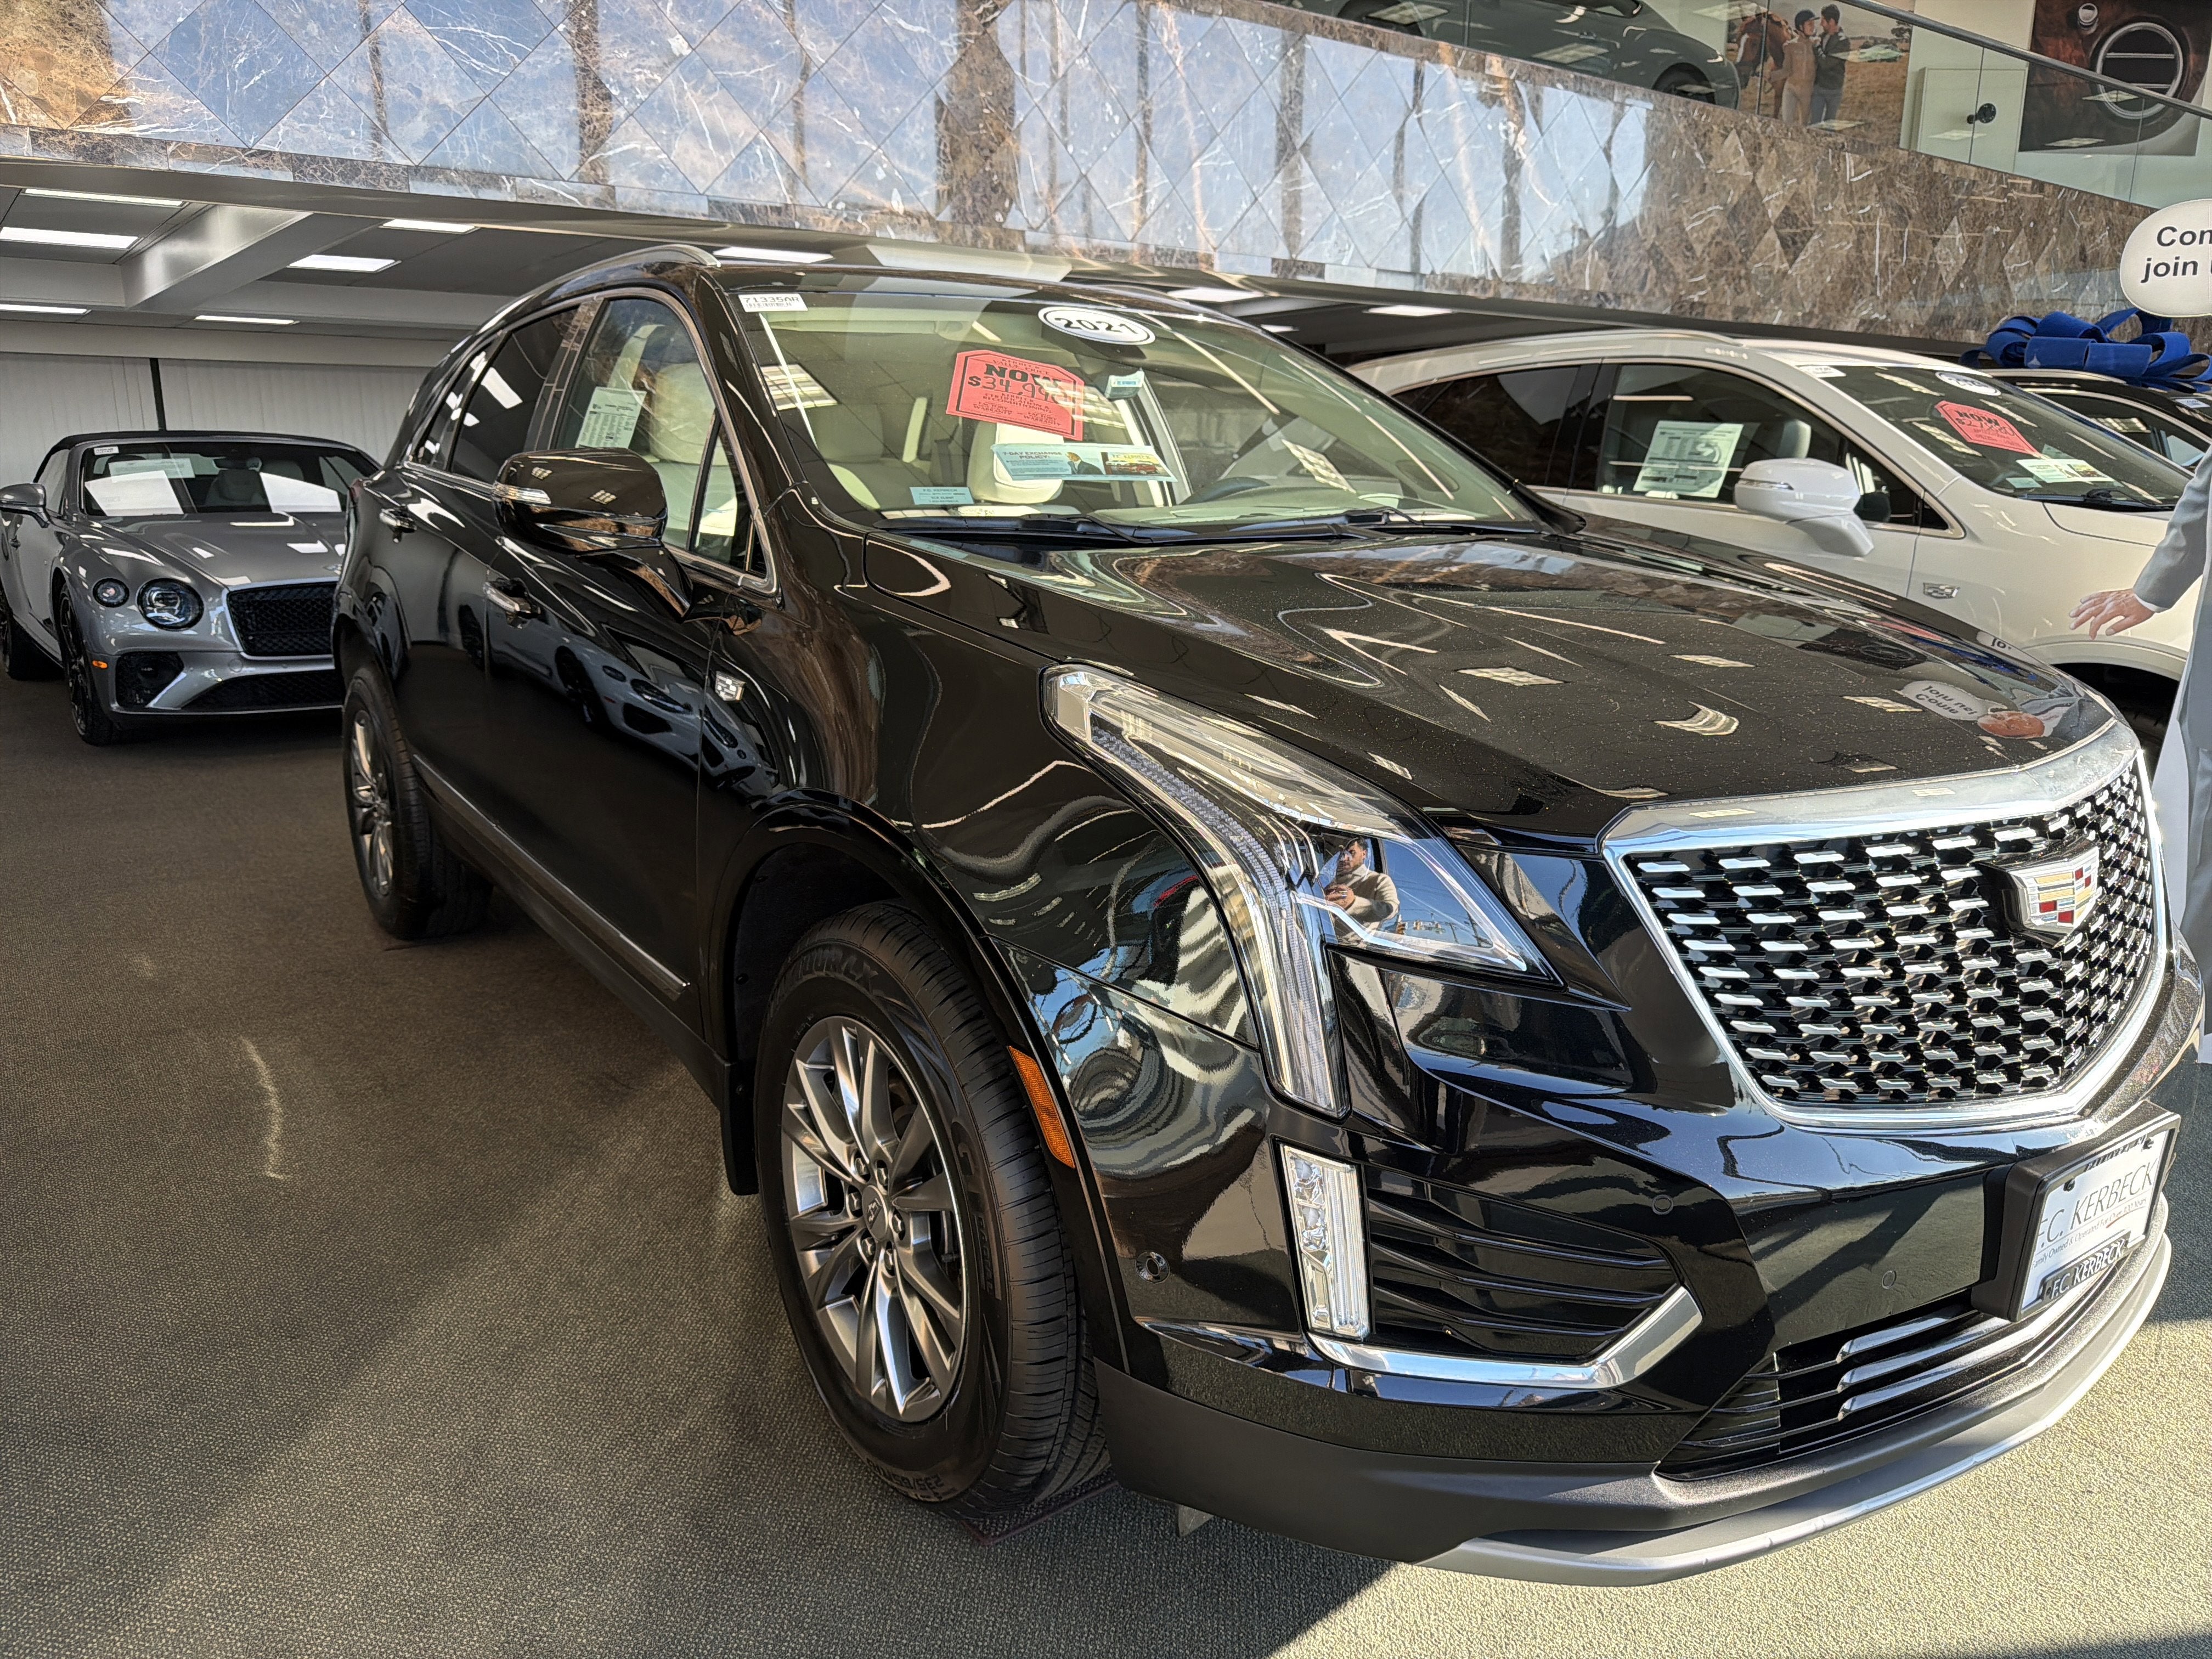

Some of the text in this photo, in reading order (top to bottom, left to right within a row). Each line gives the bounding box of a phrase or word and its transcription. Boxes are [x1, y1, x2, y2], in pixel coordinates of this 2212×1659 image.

[2140, 256, 2198, 283] join
[1054, 318, 1138, 334] 2021
[984, 363, 1062, 388] NOW
[2070, 1158, 2158, 1230] KERBECK
[2051, 1238, 2125, 1300] F.C. KERBECK
